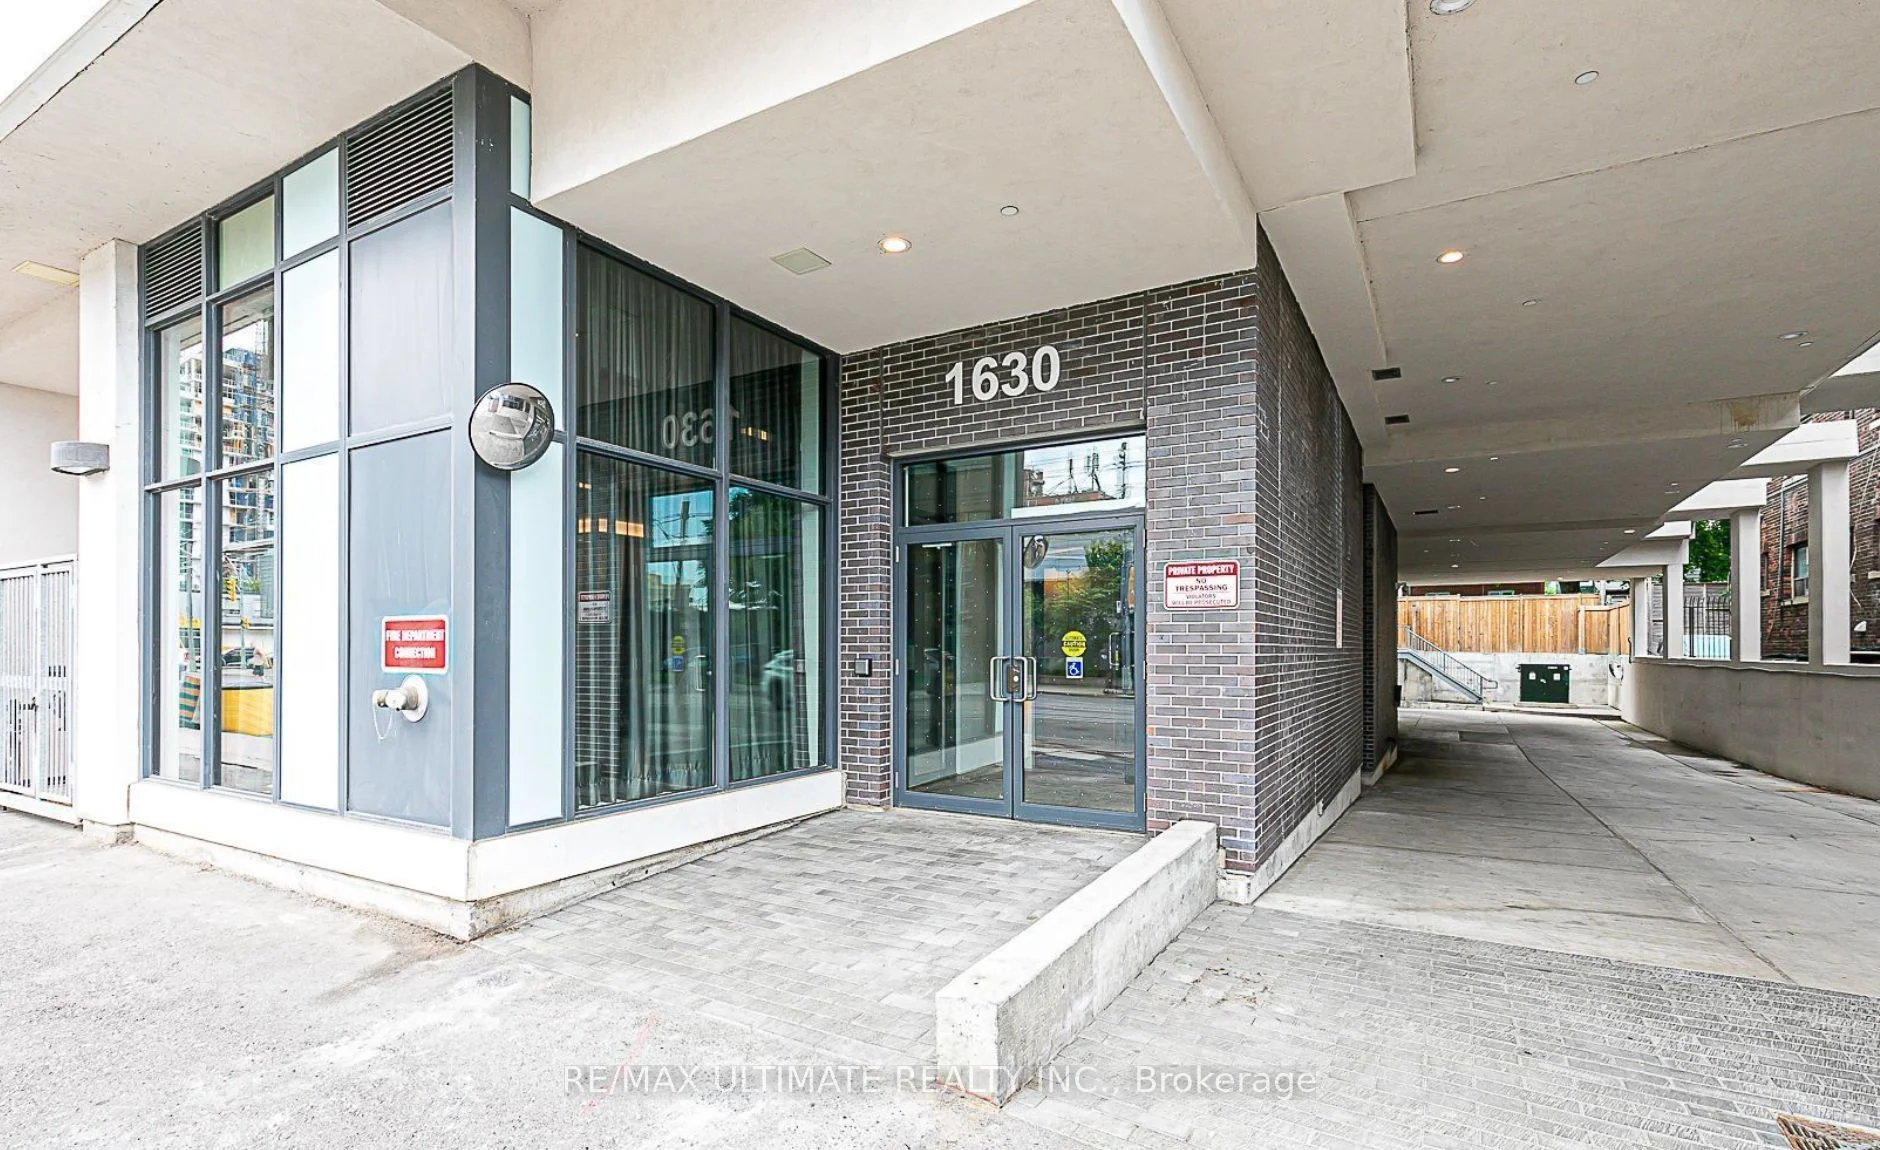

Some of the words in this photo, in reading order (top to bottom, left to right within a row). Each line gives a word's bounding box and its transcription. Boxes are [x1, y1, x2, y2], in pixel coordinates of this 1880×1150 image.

[945, 345, 1060, 405] 1630
[1168, 566, 1196, 576] PRIVATE
[1198, 564, 1235, 575] PROPERTY
[1175, 584, 1228, 592] TRESPASSING
